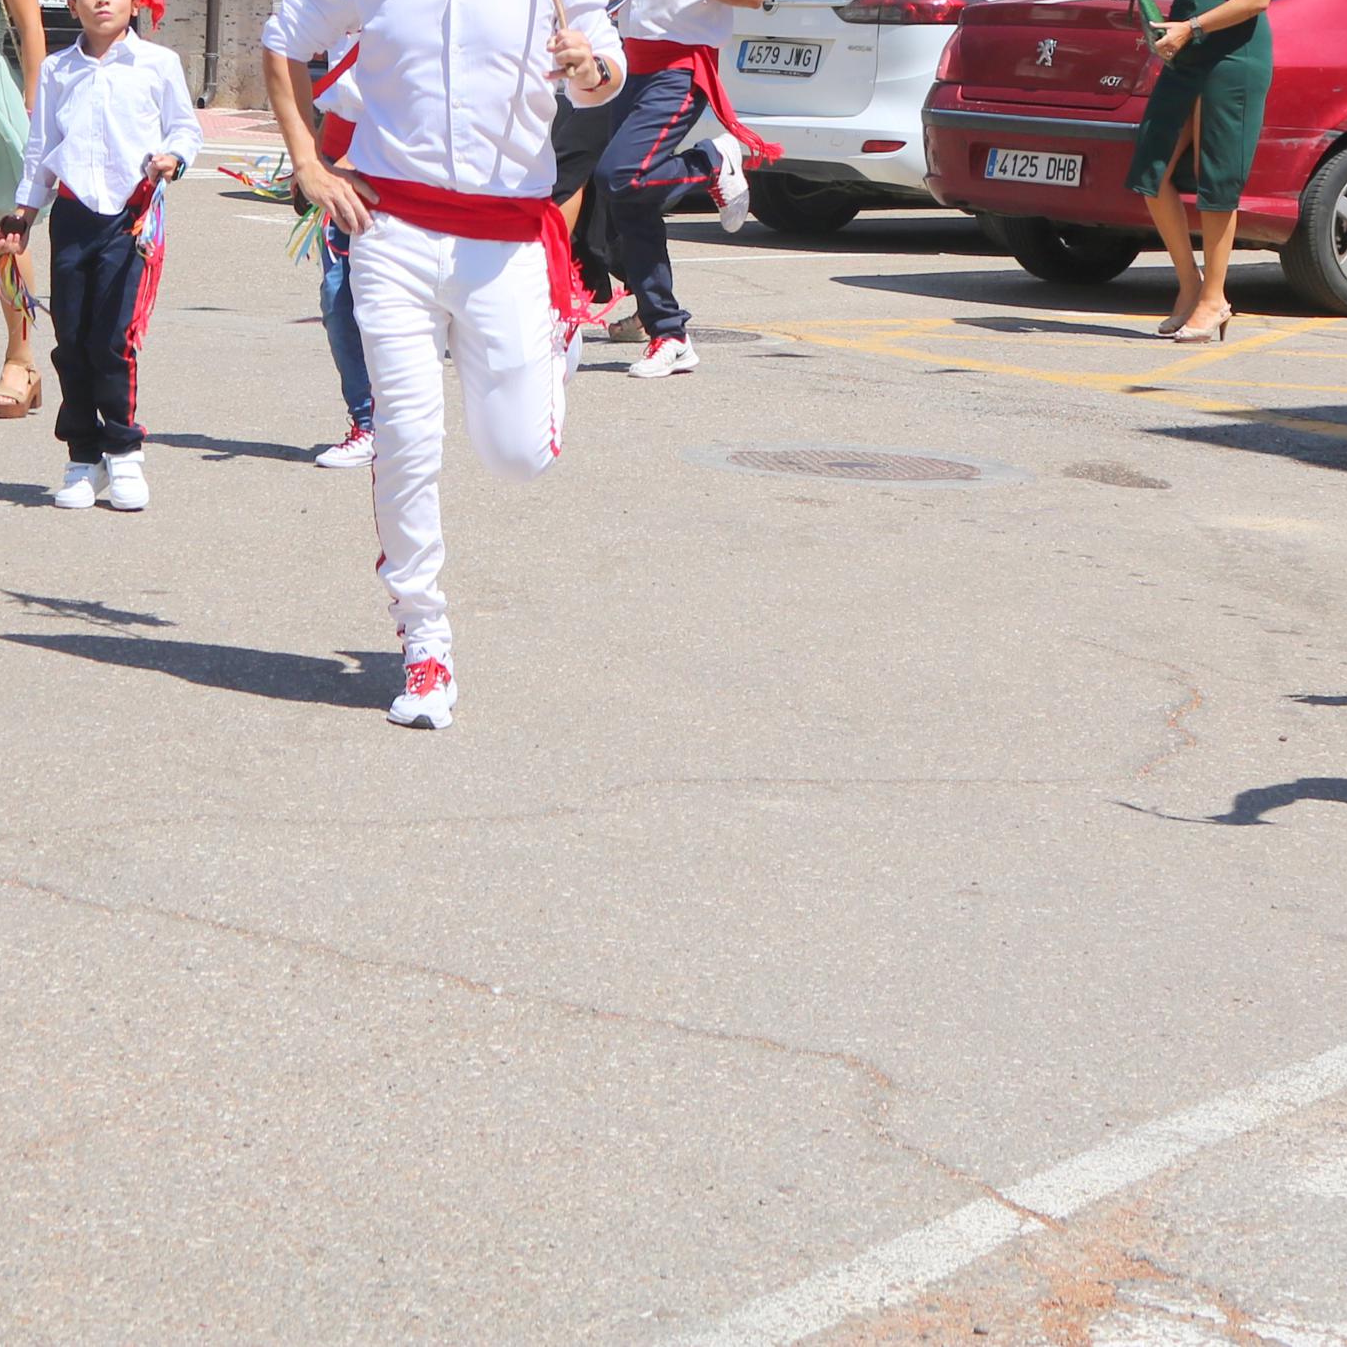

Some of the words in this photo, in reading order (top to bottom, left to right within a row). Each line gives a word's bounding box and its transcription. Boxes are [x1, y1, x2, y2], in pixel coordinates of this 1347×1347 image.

[747, 45, 781, 64] 4579
[784, 46, 812, 67] JWG
[1099, 75, 1124, 87] 407
[998, 153, 1039, 177] 4125
[1045, 157, 1077, 182] DHB
